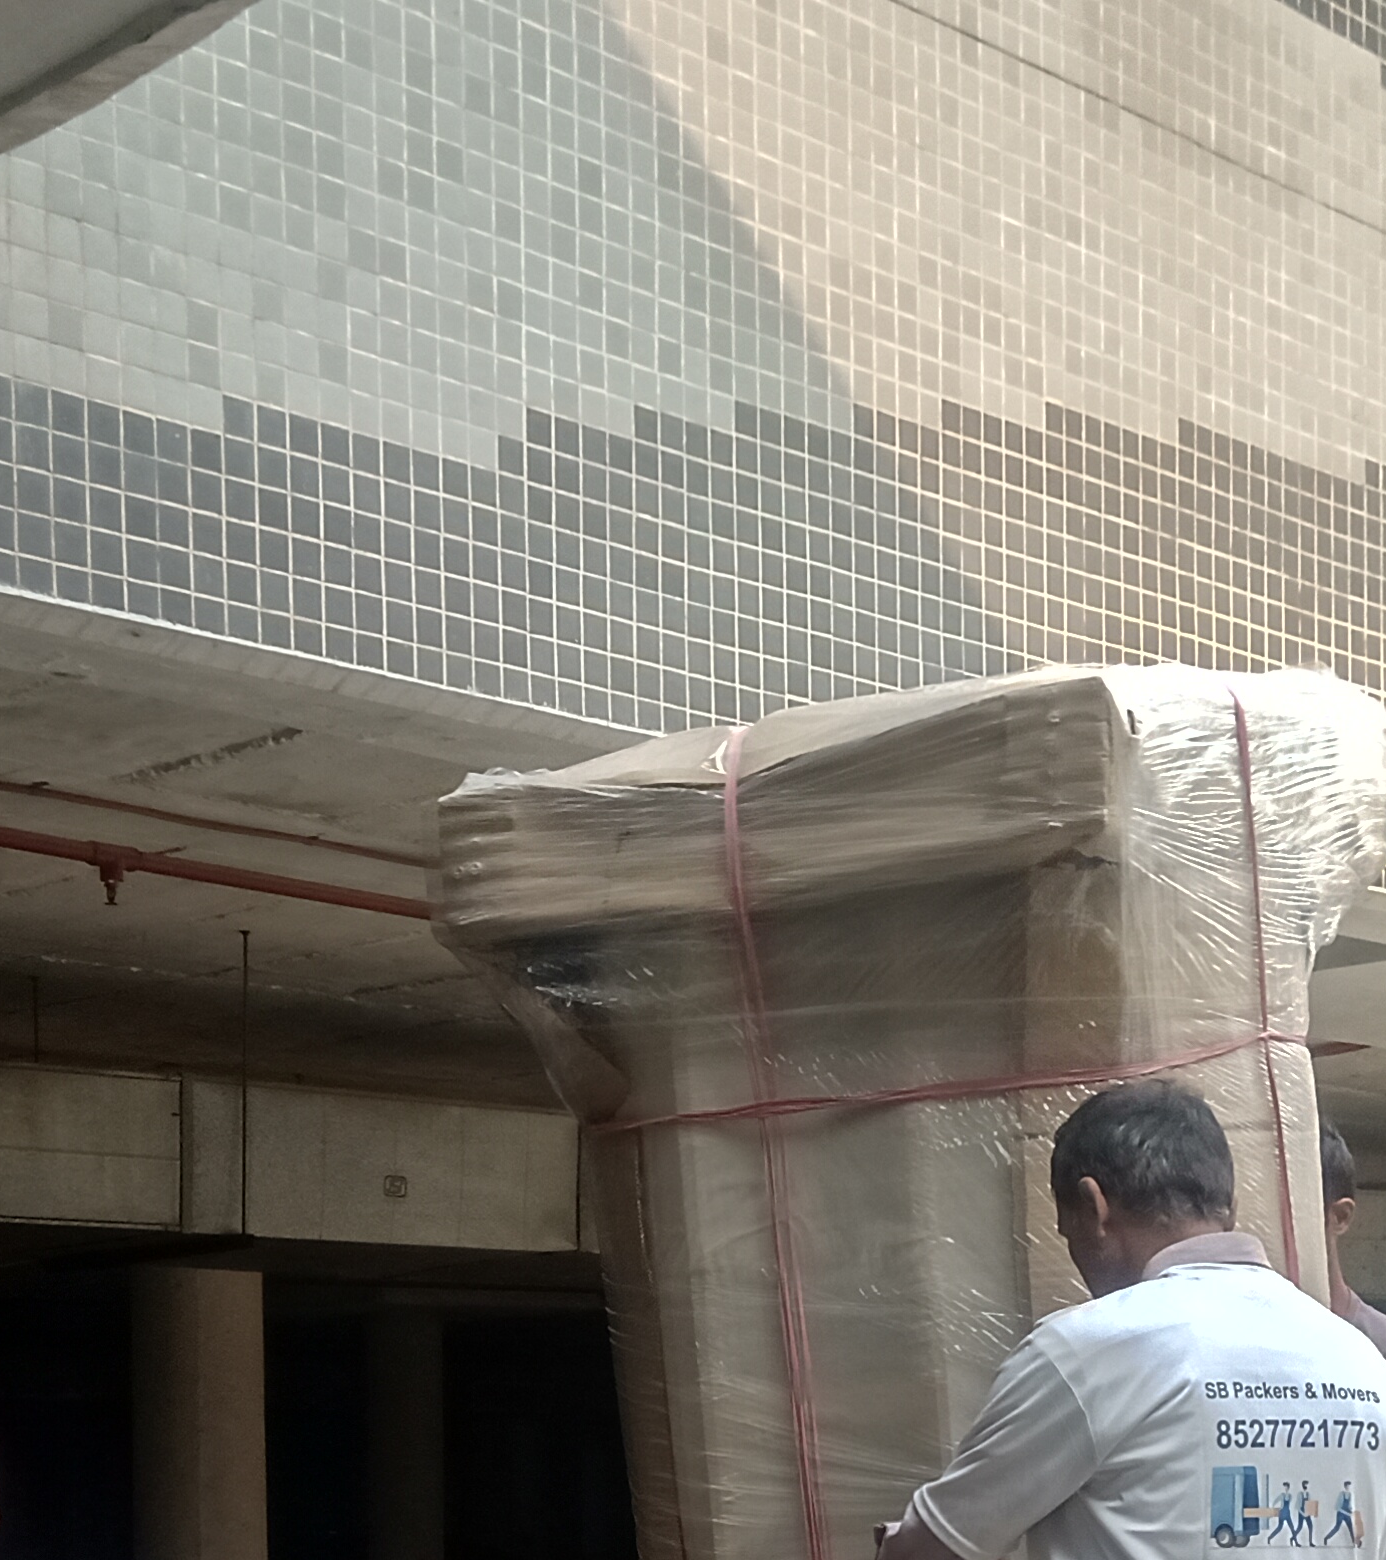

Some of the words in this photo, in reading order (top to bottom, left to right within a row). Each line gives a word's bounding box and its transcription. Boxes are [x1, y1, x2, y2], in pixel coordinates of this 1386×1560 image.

[1205, 1381, 1229, 1399] SB
[1232, 1381, 1300, 1399] Packers
[1305, 1382, 1318, 1400] &
[1321, 1382, 1381, 1404] Movers
[1216, 1418, 1380, 1451] 8527721773
